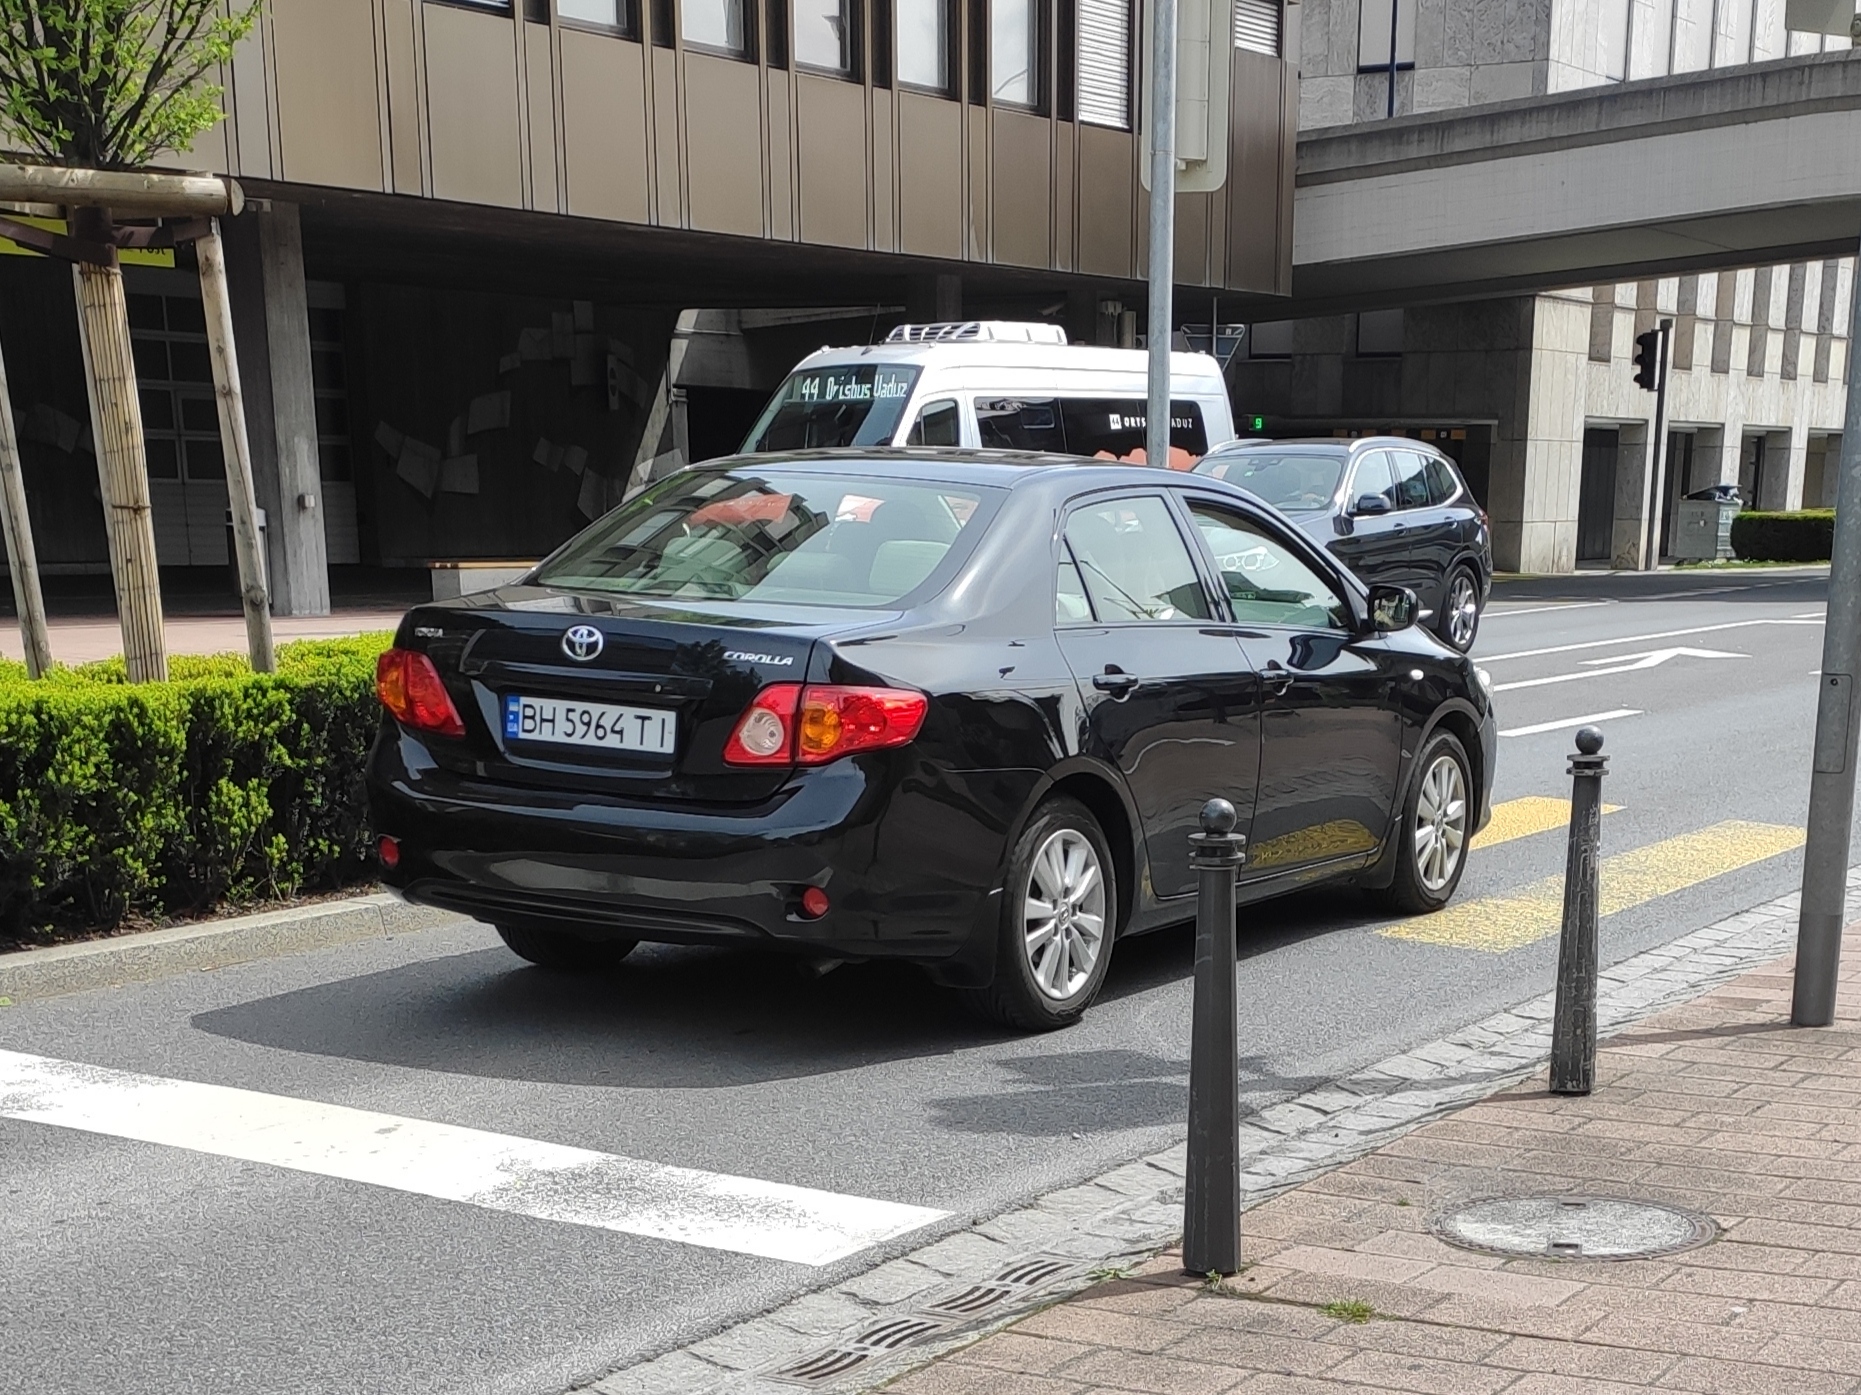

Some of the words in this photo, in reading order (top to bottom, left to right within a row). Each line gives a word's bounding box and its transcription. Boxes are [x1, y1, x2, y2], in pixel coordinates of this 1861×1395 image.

[802, 376, 819, 402] 44
[1123, 417, 1146, 428] ORTS
[1171, 417, 1193, 429] ADUZ
[722, 650, 794, 666] COROLLA
[521, 703, 557, 736] BH
[563, 708, 625, 744] 5964
[633, 714, 666, 748] TI
